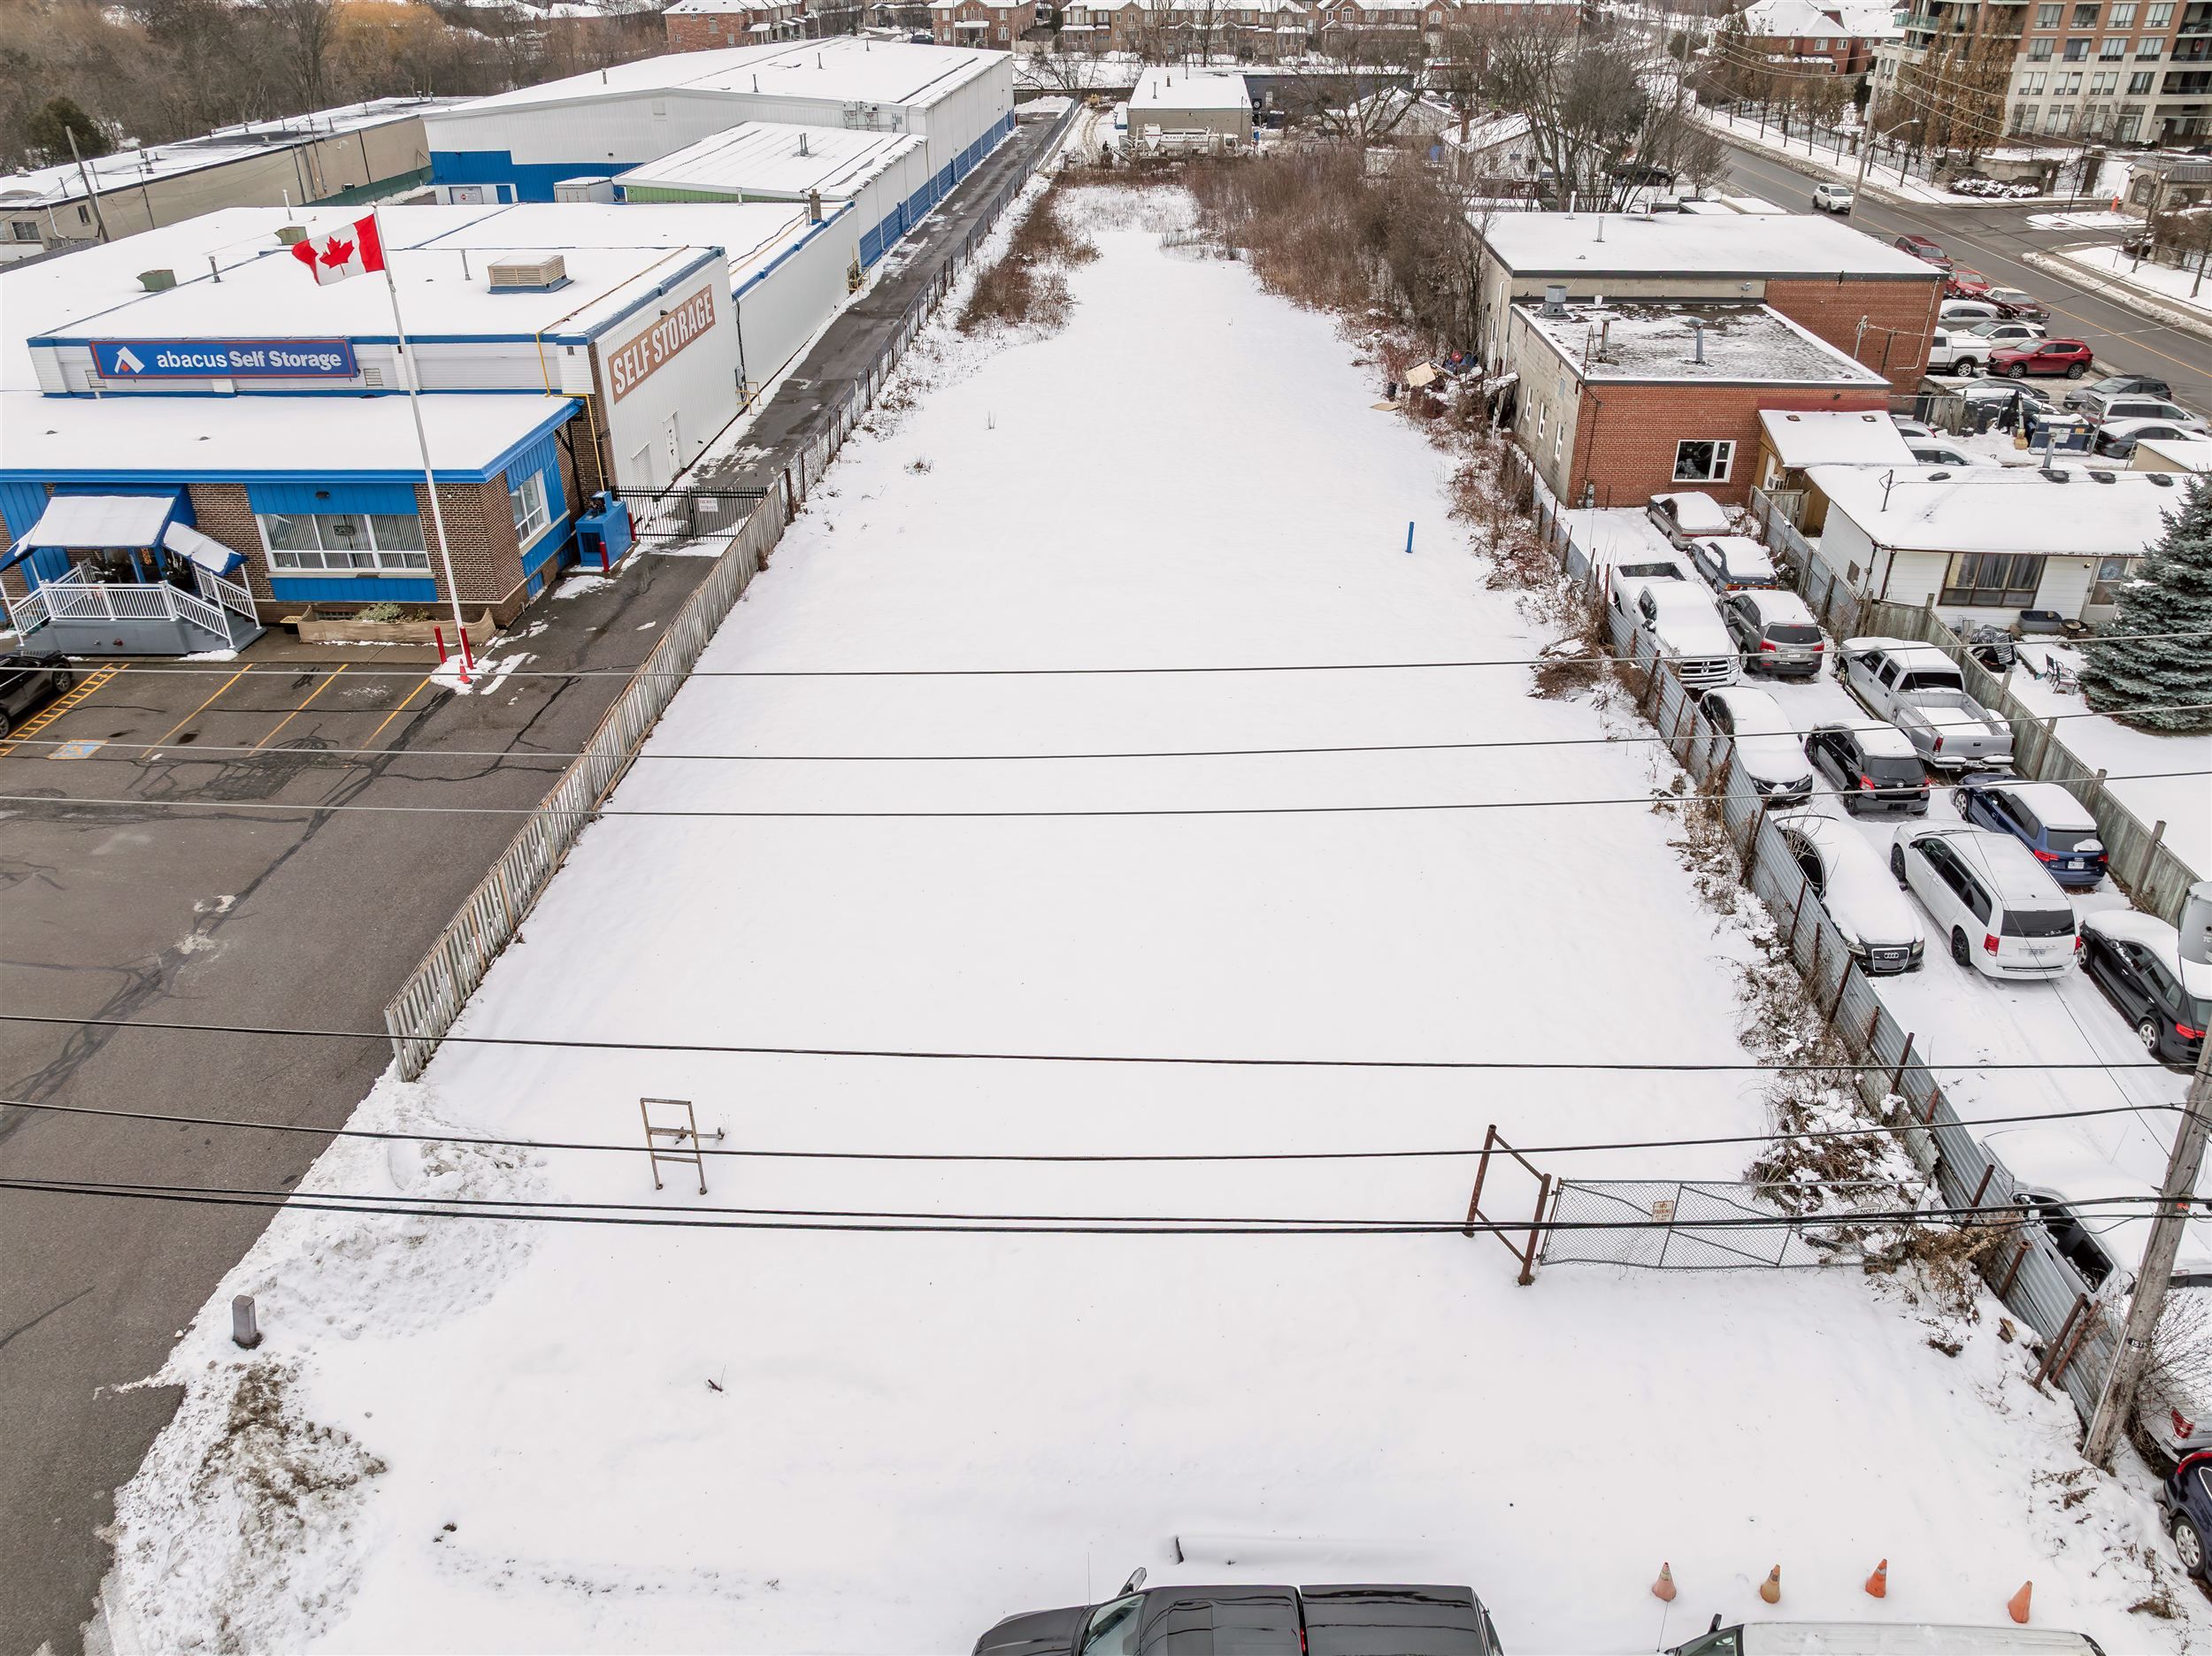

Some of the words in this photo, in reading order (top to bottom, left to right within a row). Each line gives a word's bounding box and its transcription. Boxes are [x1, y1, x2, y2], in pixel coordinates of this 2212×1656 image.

[156, 350, 227, 369] abacus
[230, 350, 265, 368] Self
[270, 350, 342, 371] Storage
[613, 336, 650, 395] SELF
[651, 291, 713, 364] STORAGE
